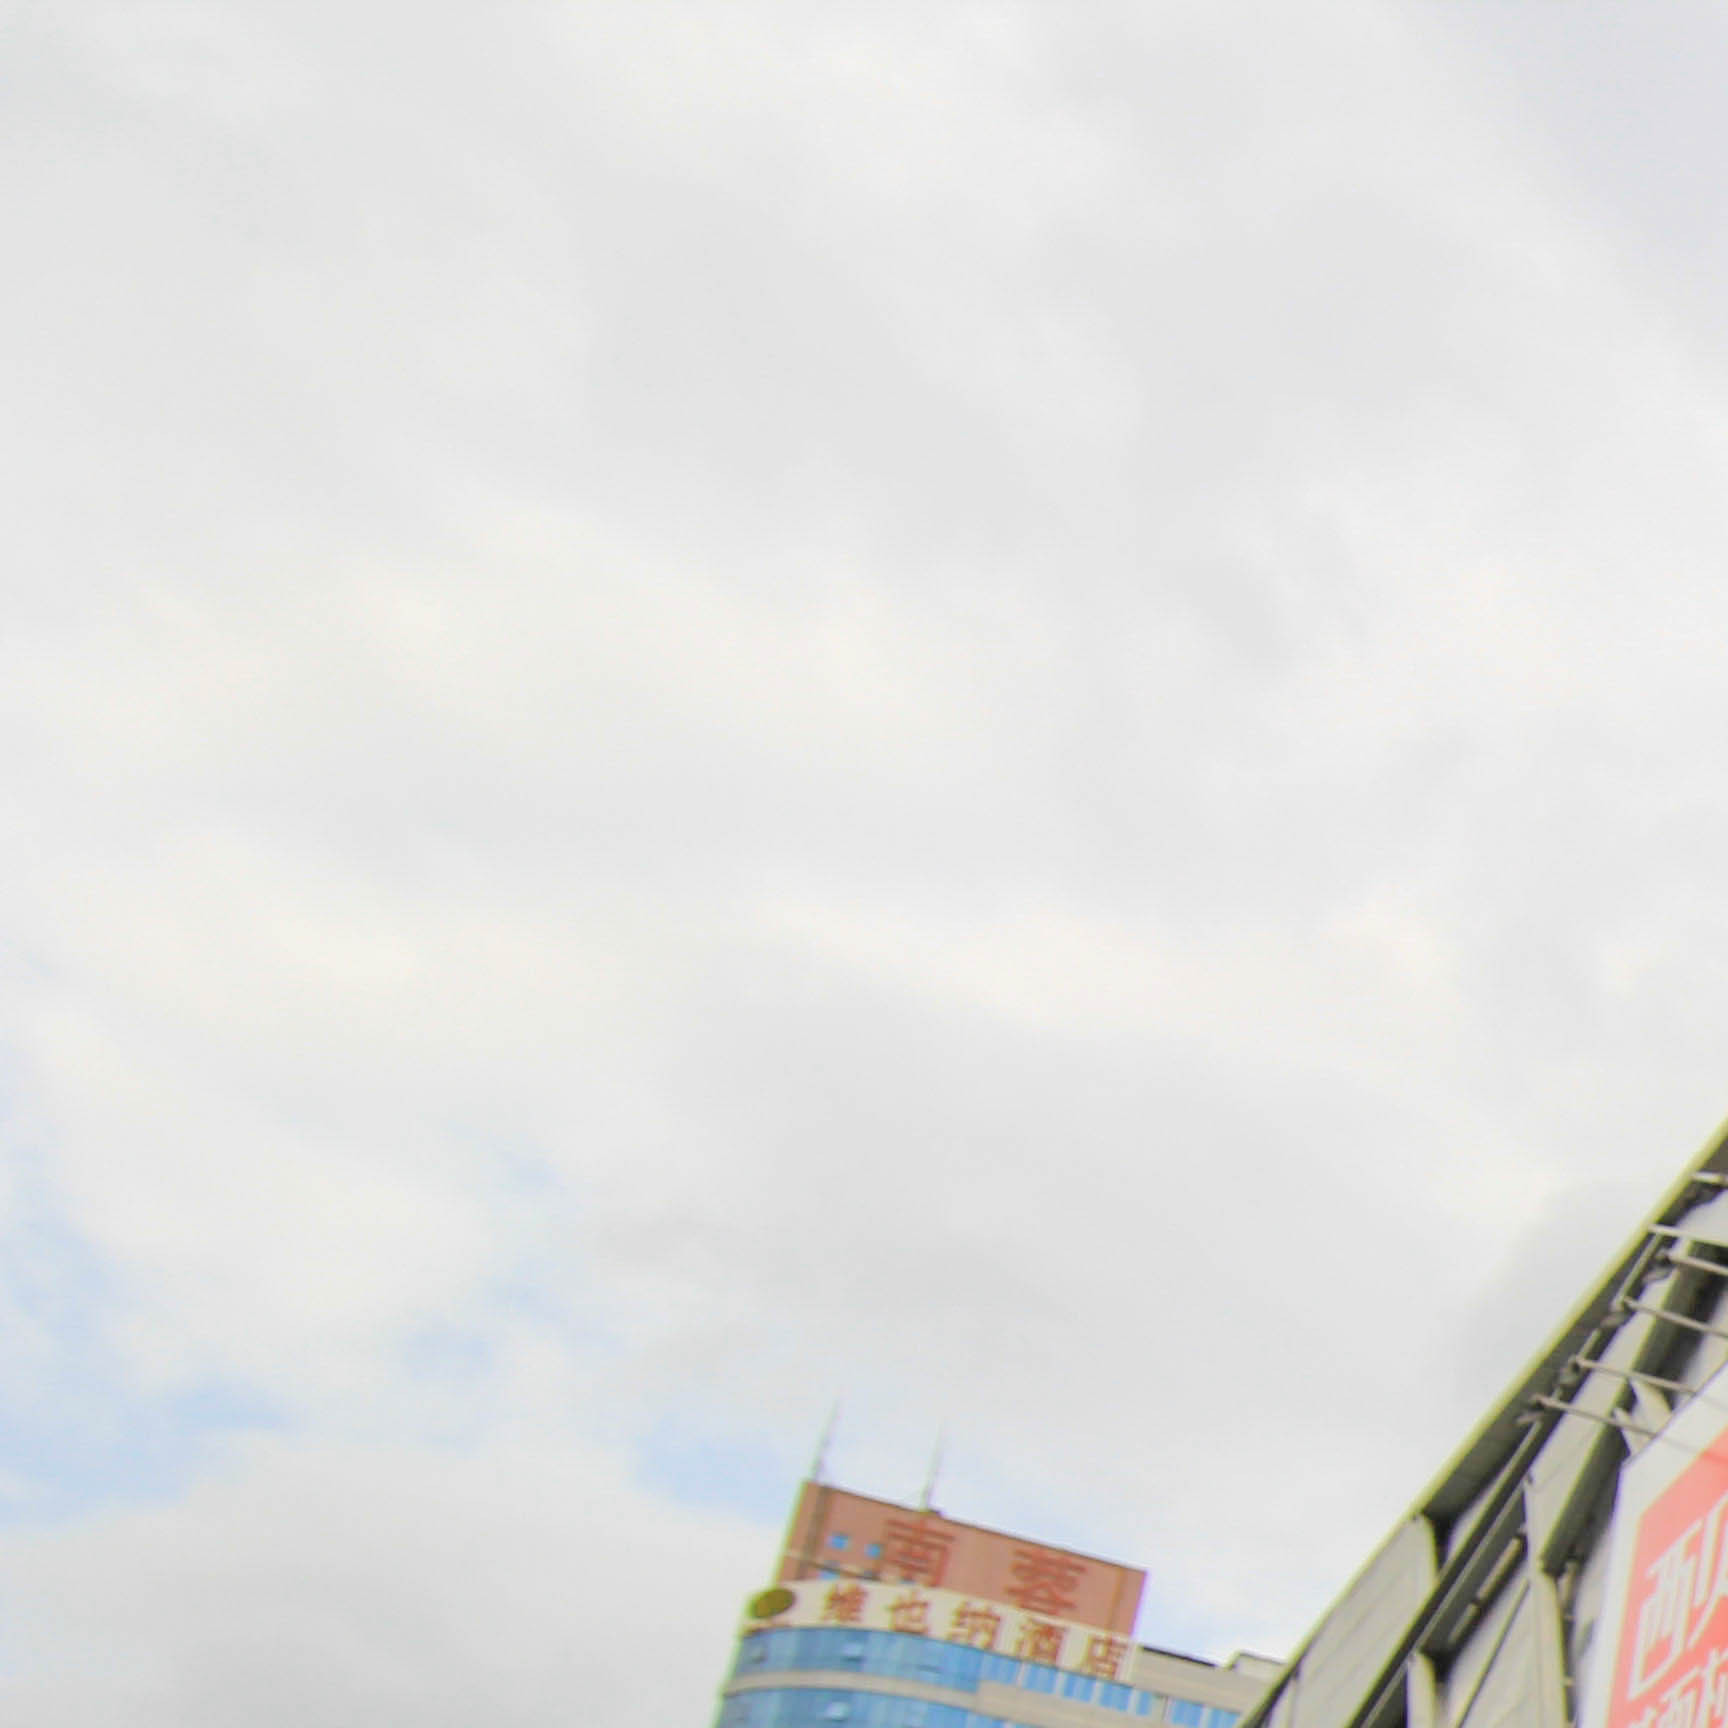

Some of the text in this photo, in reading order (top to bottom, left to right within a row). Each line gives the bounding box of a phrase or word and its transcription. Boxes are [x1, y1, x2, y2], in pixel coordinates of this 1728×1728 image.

[822, 1582, 1128, 1681] 维也纳酒店
